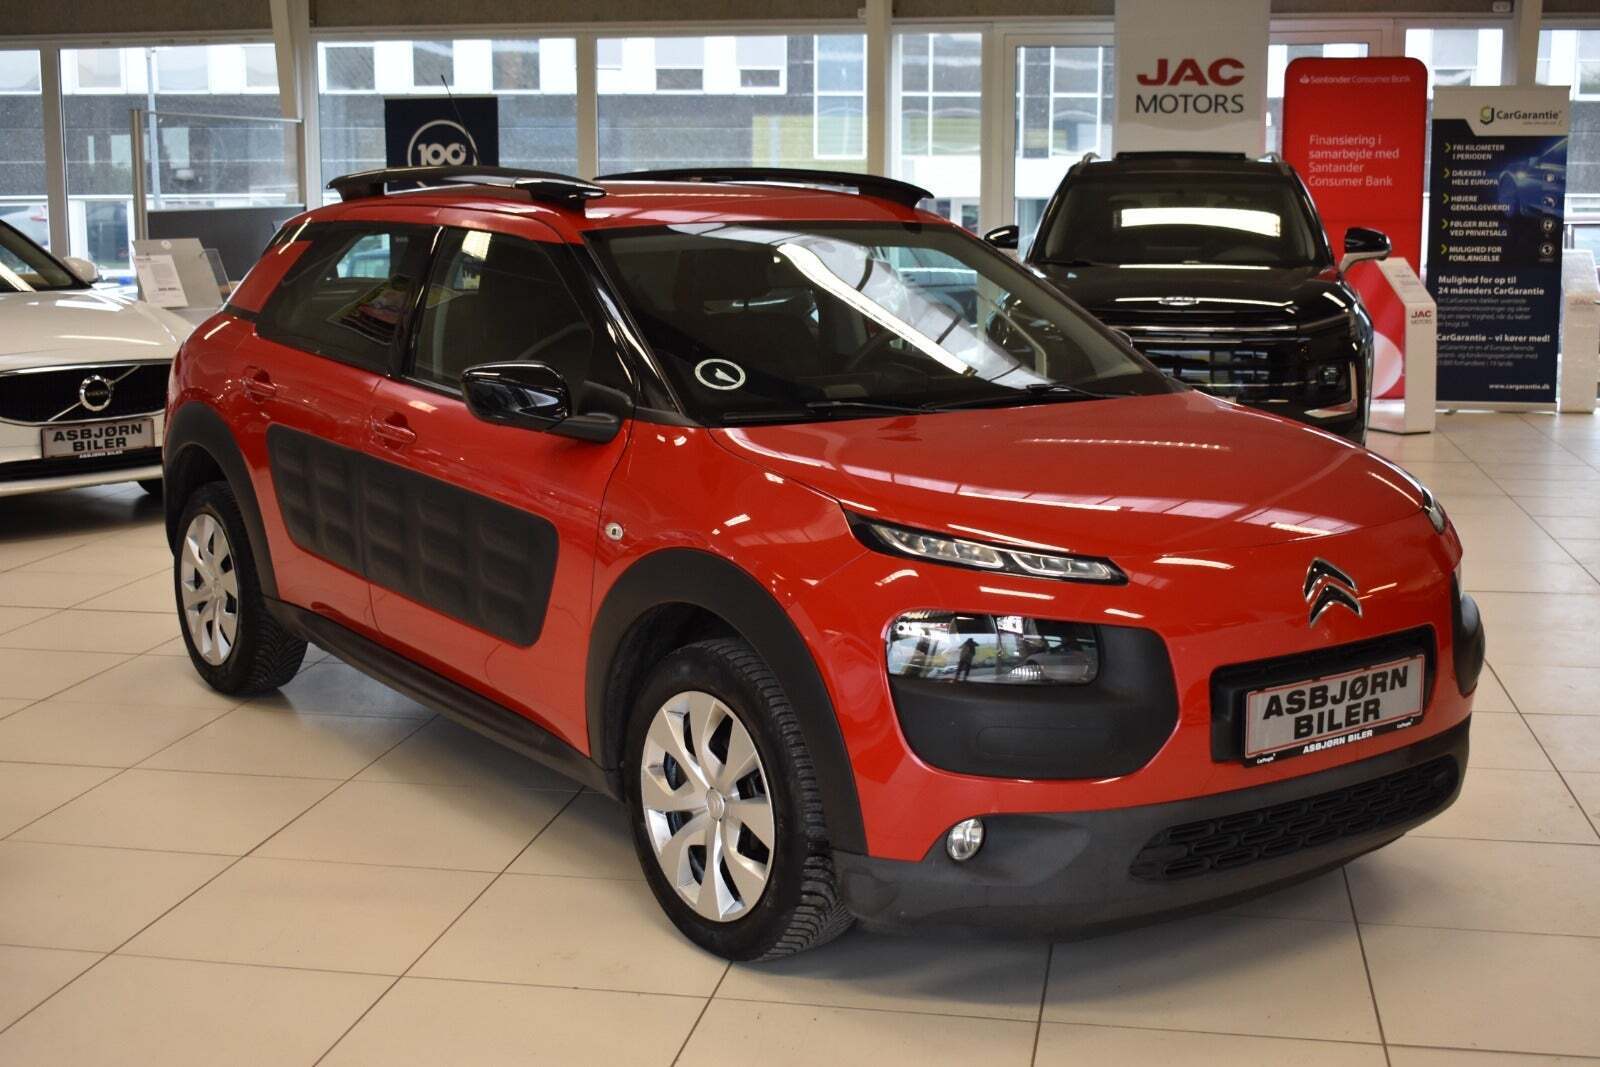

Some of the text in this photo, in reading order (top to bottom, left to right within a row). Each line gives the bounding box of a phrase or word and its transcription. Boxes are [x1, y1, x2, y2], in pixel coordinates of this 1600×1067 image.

[1136, 58, 1245, 86] JAC
[1136, 94, 1244, 114] MOTORS
[1309, 134, 1381, 148] Finansiering i
[1465, 144, 1505, 152] KILOMETER
[1309, 148, 1399, 161] samarbejde med
[1456, 153, 1492, 161] PERIODEN
[1308, 161, 1364, 173] Santander
[1309, 176, 1393, 187] Consumer Bank
[1451, 178, 1469, 186] HELE
[1450, 220, 1477, 228] FØLGER
[1450, 229, 1507, 237] VED PRIVATSALG
[1449, 246, 1502, 254] MULIGHED FOR
[1438, 275, 1517, 286] Mulighed for op til
[1438, 286, 1544, 296] 24 måneders CarGarantie
[1411, 310, 1432, 318] JAC
[1437, 333, 1487, 342] CarGarantie
[1494, 334, 1503, 342] vi
[1504, 333, 1526, 342] kører
[1529, 334, 1550, 342] med!
[54, 423, 142, 442] ASBJØRN
[73, 437, 127, 452] BILER
[1263, 665, 1408, 720] ASBJØRN
[1294, 698, 1381, 740] BILER
[1302, 729, 1373, 755] ASBJØRN BILER
